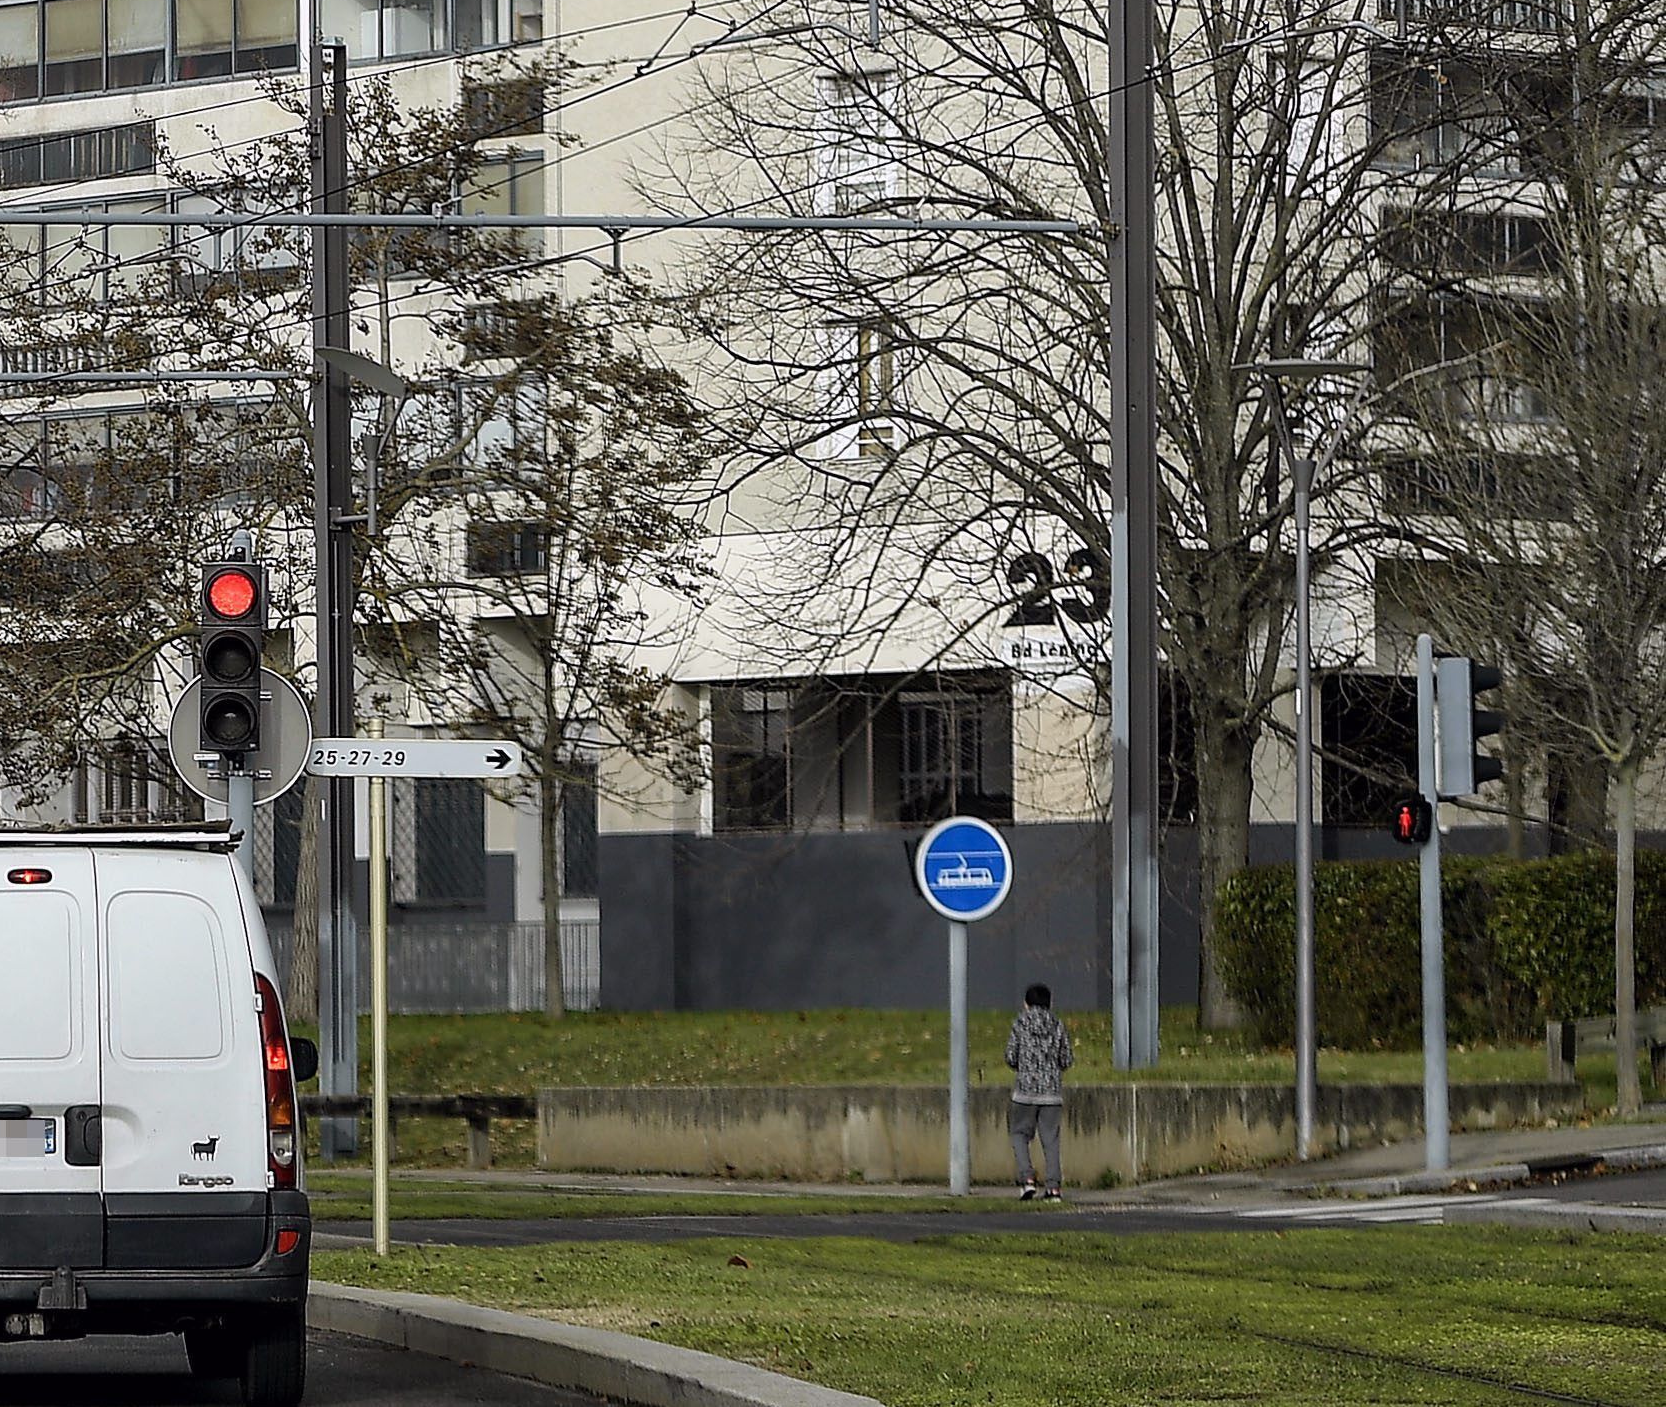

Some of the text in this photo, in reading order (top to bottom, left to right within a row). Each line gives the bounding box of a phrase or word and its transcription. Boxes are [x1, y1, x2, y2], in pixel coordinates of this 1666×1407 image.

[1003, 548, 1110, 627] 23
[313, 750, 406, 766] 25-27-29
[178, 1173, 234, 1188] Kangoo
